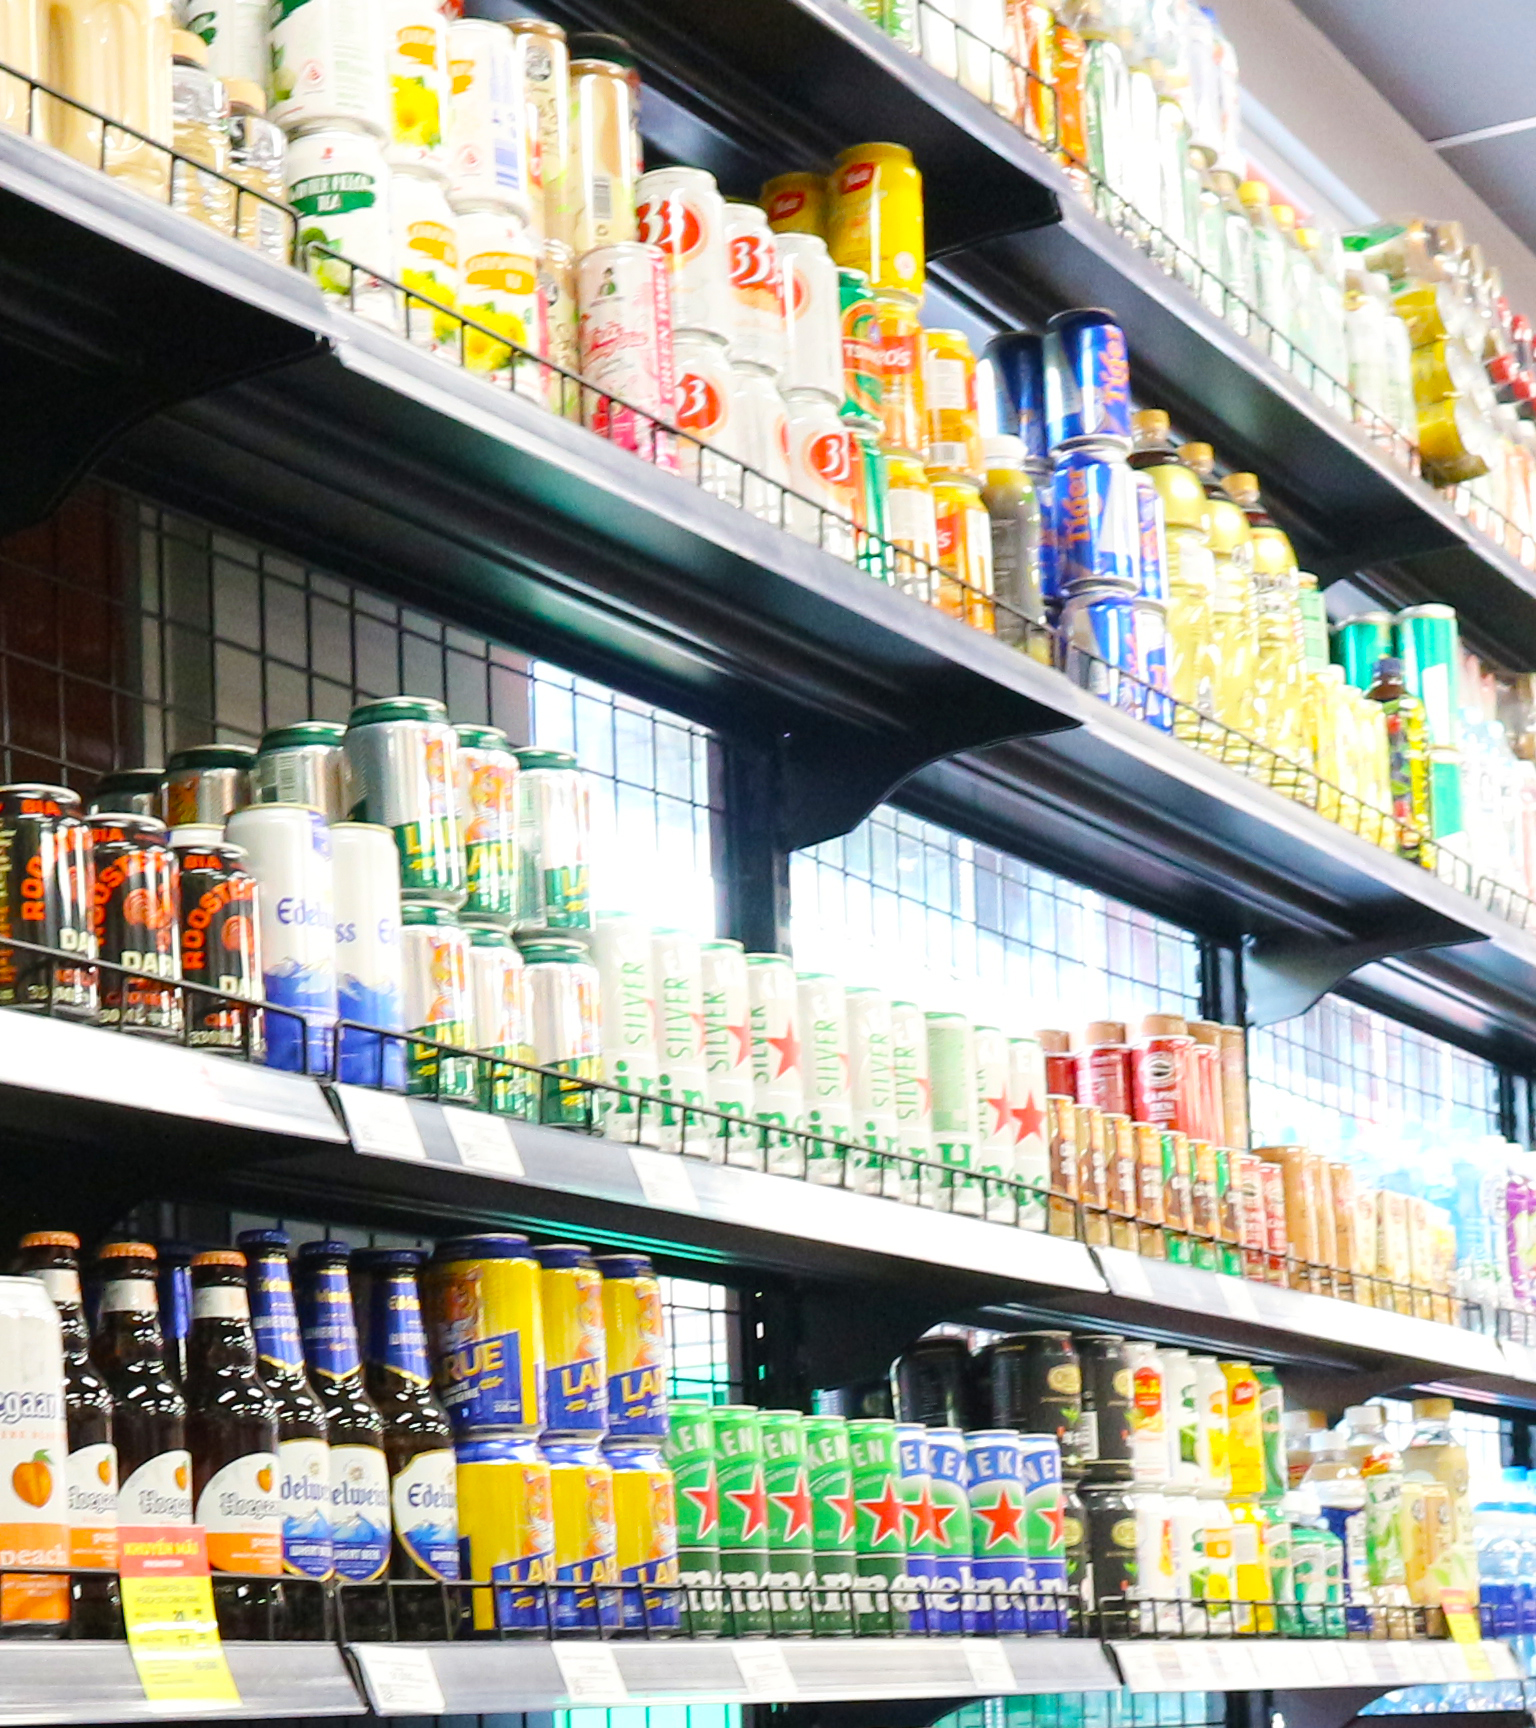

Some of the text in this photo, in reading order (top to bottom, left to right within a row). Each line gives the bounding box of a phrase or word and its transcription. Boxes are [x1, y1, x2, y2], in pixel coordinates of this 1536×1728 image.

[21, 799, 62, 817] BIA
[183, 854, 223, 871] BIA
[622, 961, 646, 1046] SILVER
[665, 976, 692, 1059] SILVER
